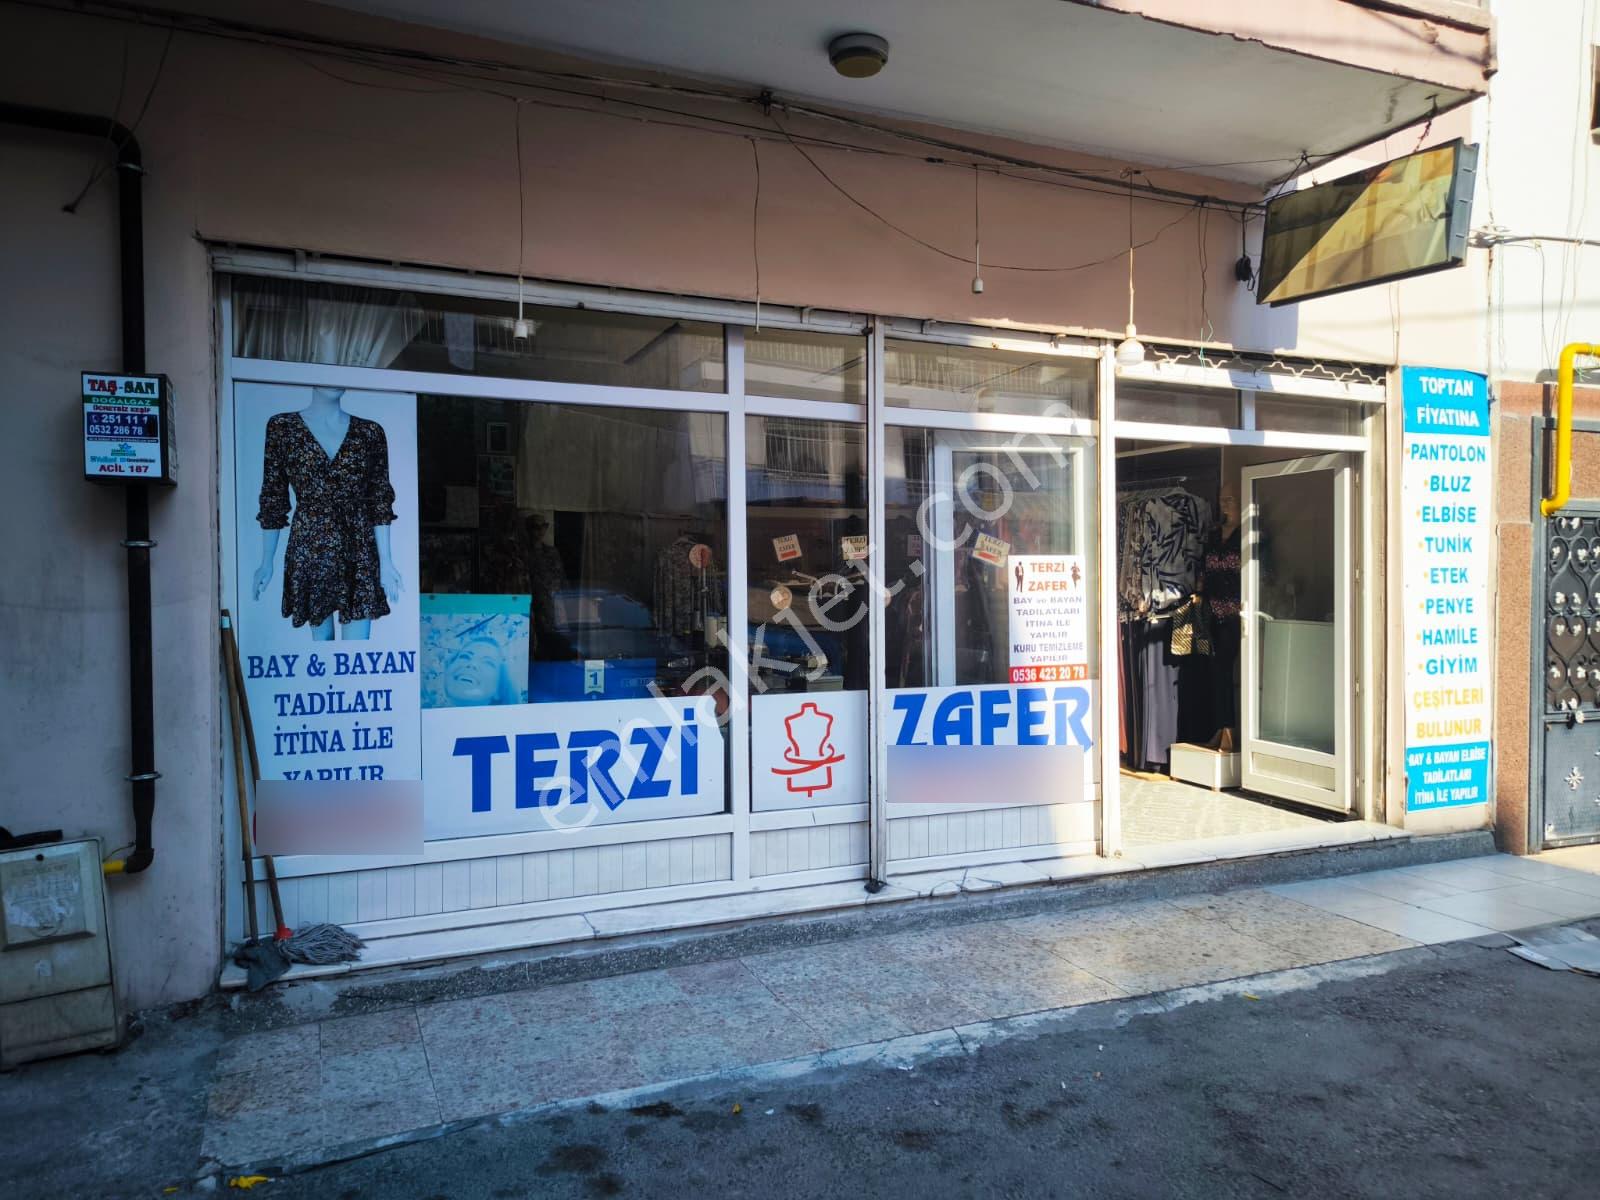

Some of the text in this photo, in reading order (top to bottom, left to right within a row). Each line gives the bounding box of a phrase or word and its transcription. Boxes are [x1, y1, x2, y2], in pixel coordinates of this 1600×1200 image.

[1419, 376, 1474, 397] TOPTAN
[101, 414, 121, 424] 251
[1417, 403, 1480, 428] FİYATINA
[89, 424, 111, 434] 0532
[1411, 443, 1486, 462] PANTOLON
[128, 465, 149, 473] 187
[1430, 475, 1471, 492] BLUZ
[1422, 502, 1477, 523] ELBİSE
[1424, 533, 1473, 553] TUNİK
[1029, 561, 1065, 573] TERZİ
[1430, 567, 1469, 584] ETEK
[1028, 581, 1068, 592] ZAFER
[1013, 597, 1033, 605] BAY
[1050, 596, 1082, 604] BAYAN
[1426, 597, 1473, 614] PENYE
[1030, 631, 1068, 639] YAPILIR
[1422, 624, 1478, 645] HAMİLE
[1013, 644, 1037, 654] KURU
[247, 651, 416, 679] BAY & BAYAN
[1030, 654, 1068, 663] YAPILIR
[1425, 654, 1478, 675] GİYİM
[1012, 668, 1038, 682] 0536
[1039, 668, 1057, 681] 423
[1058, 667, 1071, 680] 20
[274, 684, 392, 717] TADİLATI
[893, 686, 1093, 752] ZAFER
[1416, 718, 1482, 738] BULUNUR
[273, 721, 393, 756] İTİNA İLE
[452, 707, 698, 813] TERZİ
[1408, 753, 1424, 767] BAY
[1434, 751, 1460, 764] BAYAN
